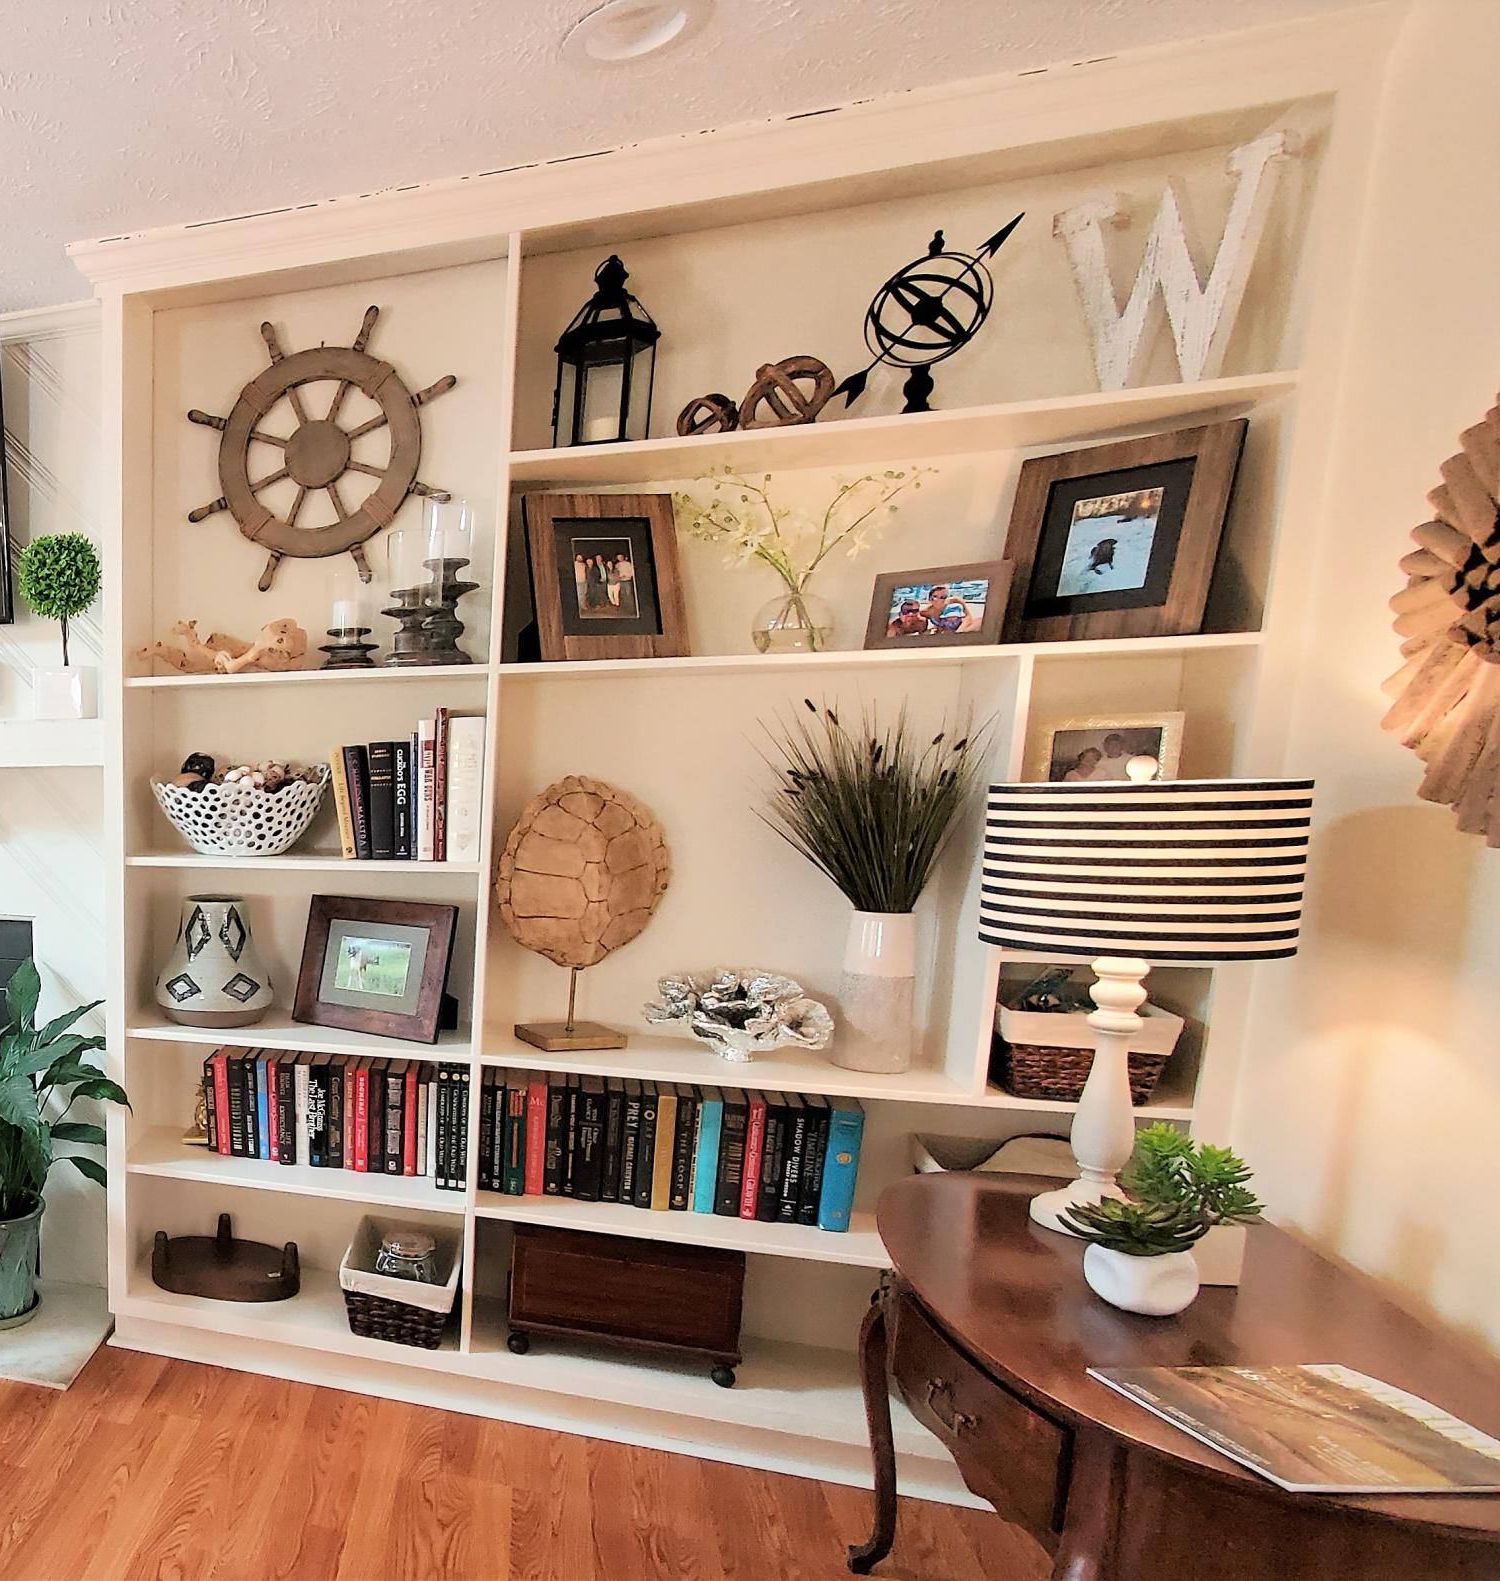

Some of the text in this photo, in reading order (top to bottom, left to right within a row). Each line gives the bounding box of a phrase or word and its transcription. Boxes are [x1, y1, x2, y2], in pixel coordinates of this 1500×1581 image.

[1052, 129, 1302, 391] W
[397, 784, 406, 804] EGG
[309, 1080, 317, 1094] The
[317, 1088, 325, 1098] Joe
[309, 1095, 317, 1110] Last
[627, 1102, 640, 1128] PREY
[790, 1118, 804, 1183] SHADOW DIVERS
